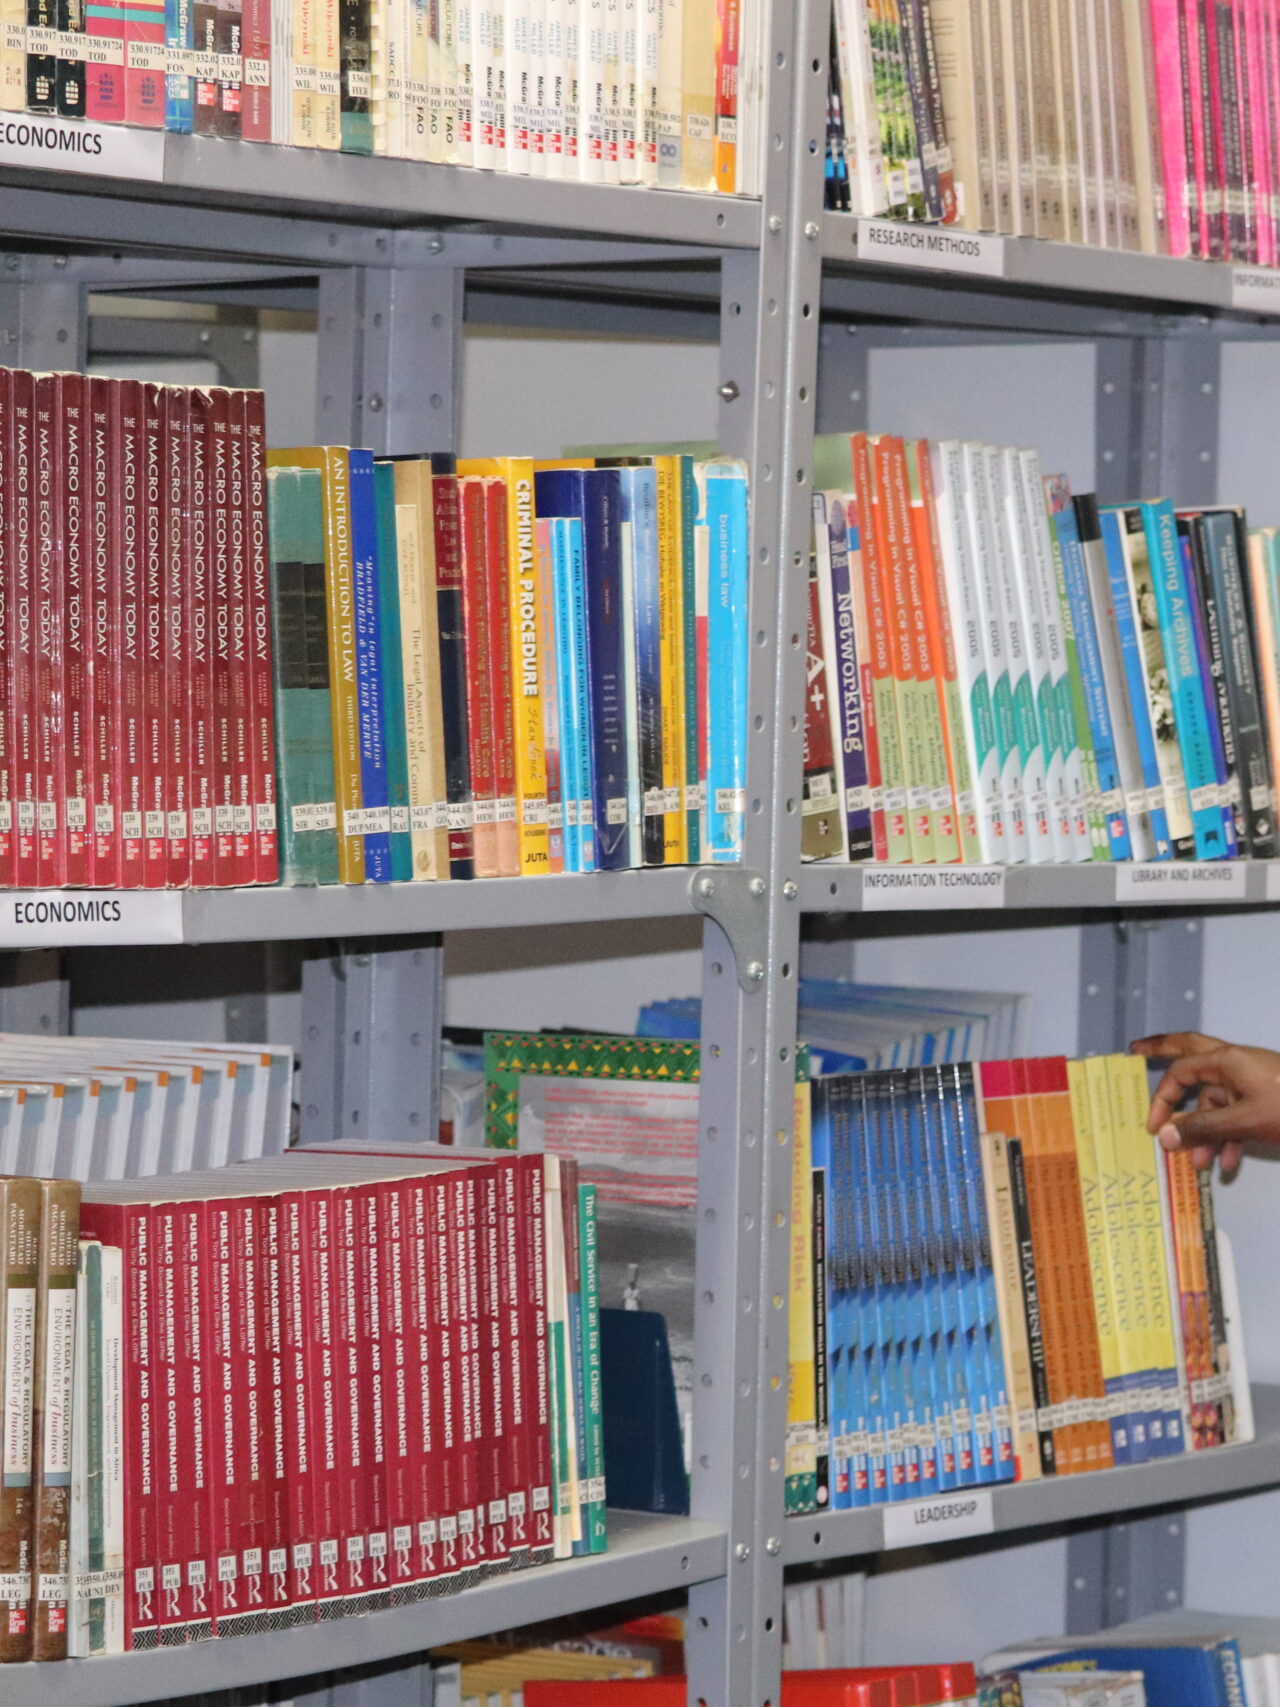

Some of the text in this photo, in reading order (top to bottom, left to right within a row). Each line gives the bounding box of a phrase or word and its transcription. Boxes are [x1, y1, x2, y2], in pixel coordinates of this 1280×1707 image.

[7, 39, 22, 48] BIN
[31, 43, 48, 52] TOD
[60, 48, 78, 57] TOD
[88, 39, 122, 50] 330.91724
[89, 52, 107, 62] TOD
[131, 57, 149, 67] TOD
[167, 63, 184, 73] FOS
[196, 66, 214, 76] KAP
[221, 69, 241, 80] KAP
[248, 73, 266, 84] ANN
[296, 80, 312, 89] WIL
[320, 83, 336, 94] WIL
[416, 107, 425, 134] FAO
[446, 116, 454, 143] FAO
[869, 228, 980, 256] RESEARCH METHODS
[17, 408, 30, 654] THE MACRO ECONOMY TODAY
[67, 408, 81, 652] THE MACRO ECONOMY TODAY
[124, 417, 136, 659] THE MACRO ECONOMY TODAY
[214, 422, 228, 660] THE MACRO ECONOMY TODAY
[250, 425, 267, 660] THE MACRO ECONOMY TODAY
[333, 457, 355, 682] AN INTRODUCTION TO LAW
[719, 514, 730, 607] business law
[882, 452, 896, 543] Programming
[893, 563, 905, 606] Visual
[900, 633, 911, 671] 2005
[515, 479, 538, 696] CRIMINAL PROCEDURE
[1159, 514, 1193, 676] Keeping Archives
[412, 629, 421, 650] The
[413, 654, 422, 686] Legal
[837, 592, 863, 753] Networking
[406, 684, 418, 760] Industry and
[415, 688, 424, 737] Aspects
[69, 814, 84, 824] SCH
[365, 822, 383, 831] MEA
[413, 820, 428, 829] FRA
[525, 853, 548, 863] JUTA
[1132, 867, 1232, 883] LIBRARY AND ARCHIVES
[865, 871, 1002, 888] INFORMATION TECHNOLOGY
[15, 900, 121, 923] ECONOMICS
[1083, 1177, 1111, 1336] Adolescence
[1121, 1170, 1149, 1328] Adolescence
[1141, 1169, 1165, 1328] Adolescence
[505, 1168, 522, 1425] PUBLIC MANAGEMENT AND GOVERNANCE
[1022, 1241, 1044, 1367] LEADERSHIP
[63, 1307, 72, 1329] THE
[345, 1199, 360, 1467] PUBLIC MANAGEMENT AND GOVERNANCE
[11, 1307, 22, 1395] ENVIRONMENT
[53, 1308, 63, 1395] ENVIRONMENT
[63, 1335, 71, 1373] LEGAL
[138, 1217, 150, 1495] PUBLIC MANAGEMENT AND GOVERNANCE
[220, 1211, 234, 1485] PUBLIC MANAGEMENT AND GOVERNANCE
[269, 1207, 284, 1479] PUBLIC MANAGEMENT AND GOVERNANCE
[10, 1409, 21, 1465] business
[21, 1389, 31, 1467] REGULATORY
[51, 1409, 62, 1465] business
[61, 1389, 71, 1466] REGULATORY
[914, 1500, 977, 1525] LEADERSHIP
[1, 1589, 21, 1599] LEG
[42, 1589, 62, 1599] LEG
[138, 1581, 153, 1591] PUB
